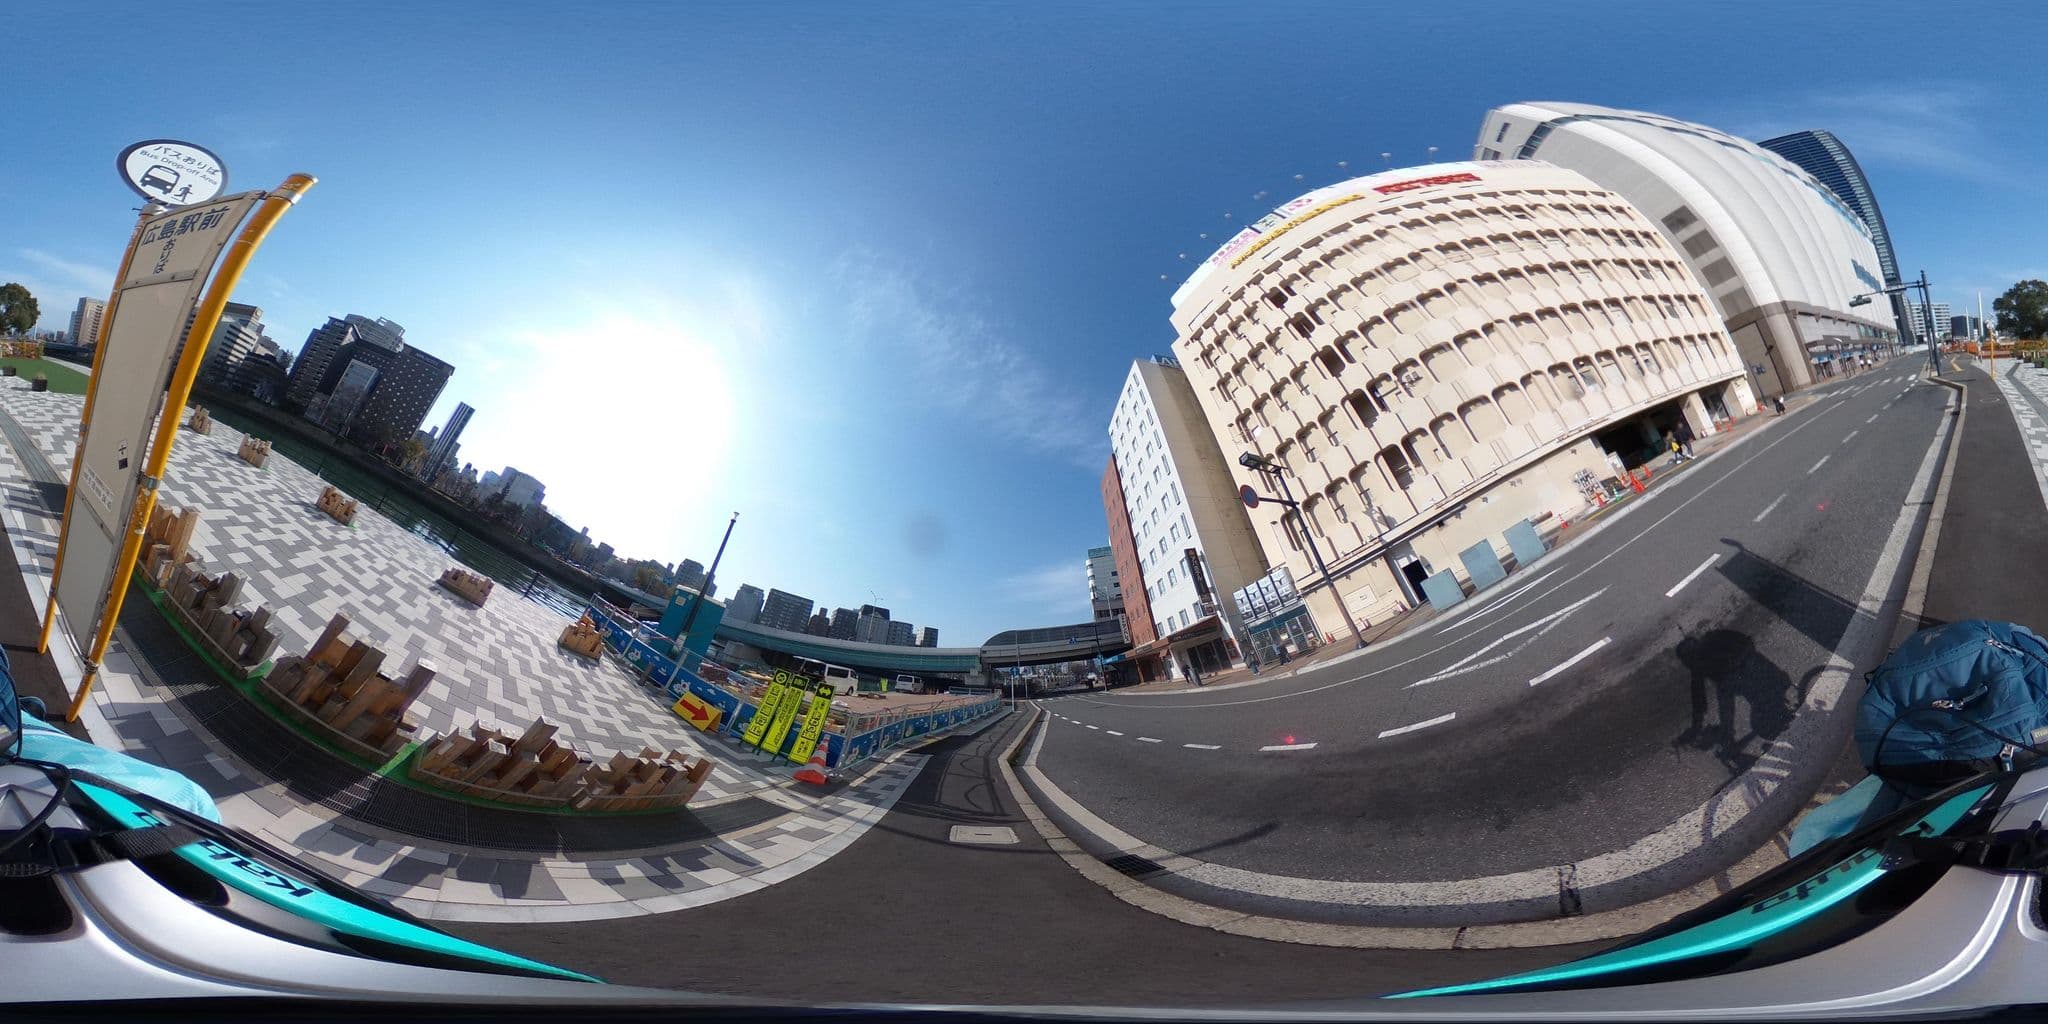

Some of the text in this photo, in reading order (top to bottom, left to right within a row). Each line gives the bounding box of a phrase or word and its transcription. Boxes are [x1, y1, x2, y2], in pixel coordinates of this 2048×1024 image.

[139, 150, 217, 186] Bus Drop-off Area
[154, 146, 220, 175] バスおりば
[142, 205, 231, 246] 広島駅前
[153, 238, 176, 275] おりば
